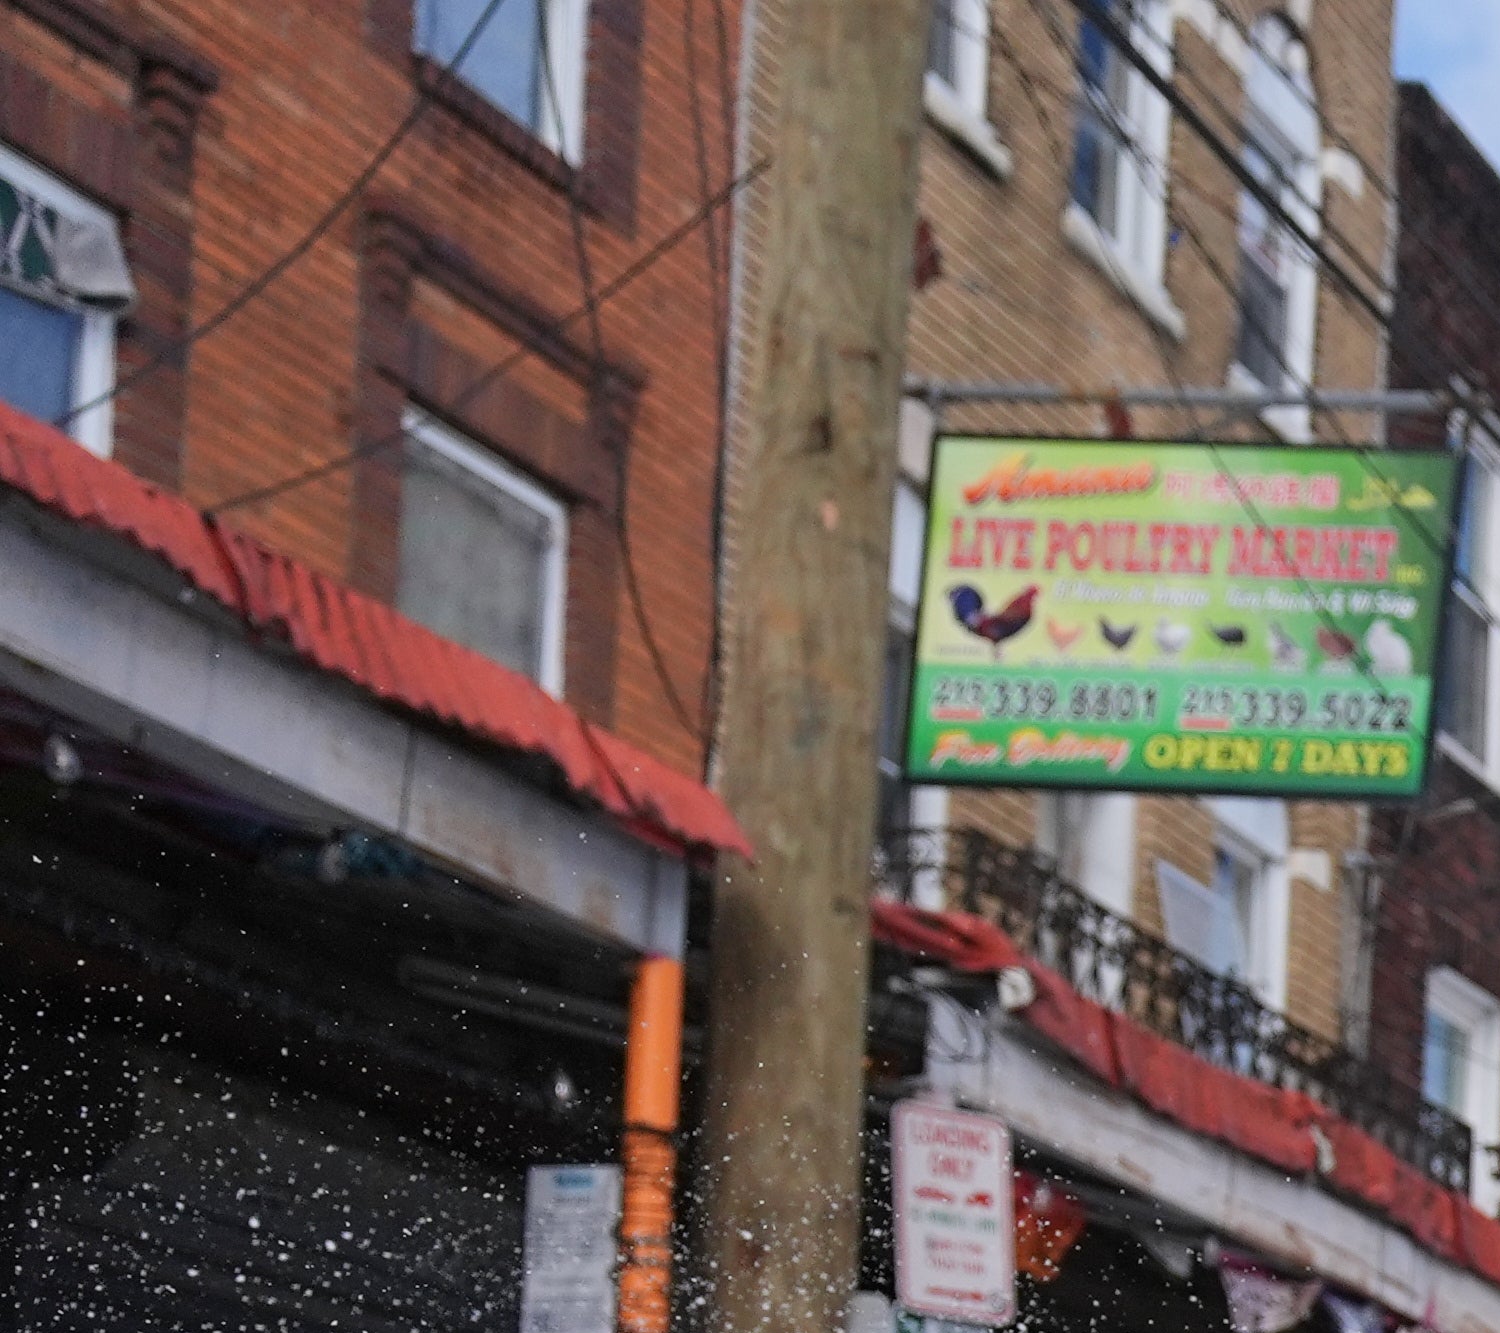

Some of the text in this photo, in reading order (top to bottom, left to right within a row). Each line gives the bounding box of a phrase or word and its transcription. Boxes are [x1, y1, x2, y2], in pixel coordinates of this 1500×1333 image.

[948, 518, 1398, 582] LIVE POULTRY MARKET
[1143, 733, 1261, 773] OPEN
[1302, 738, 1409, 778] DAYS
